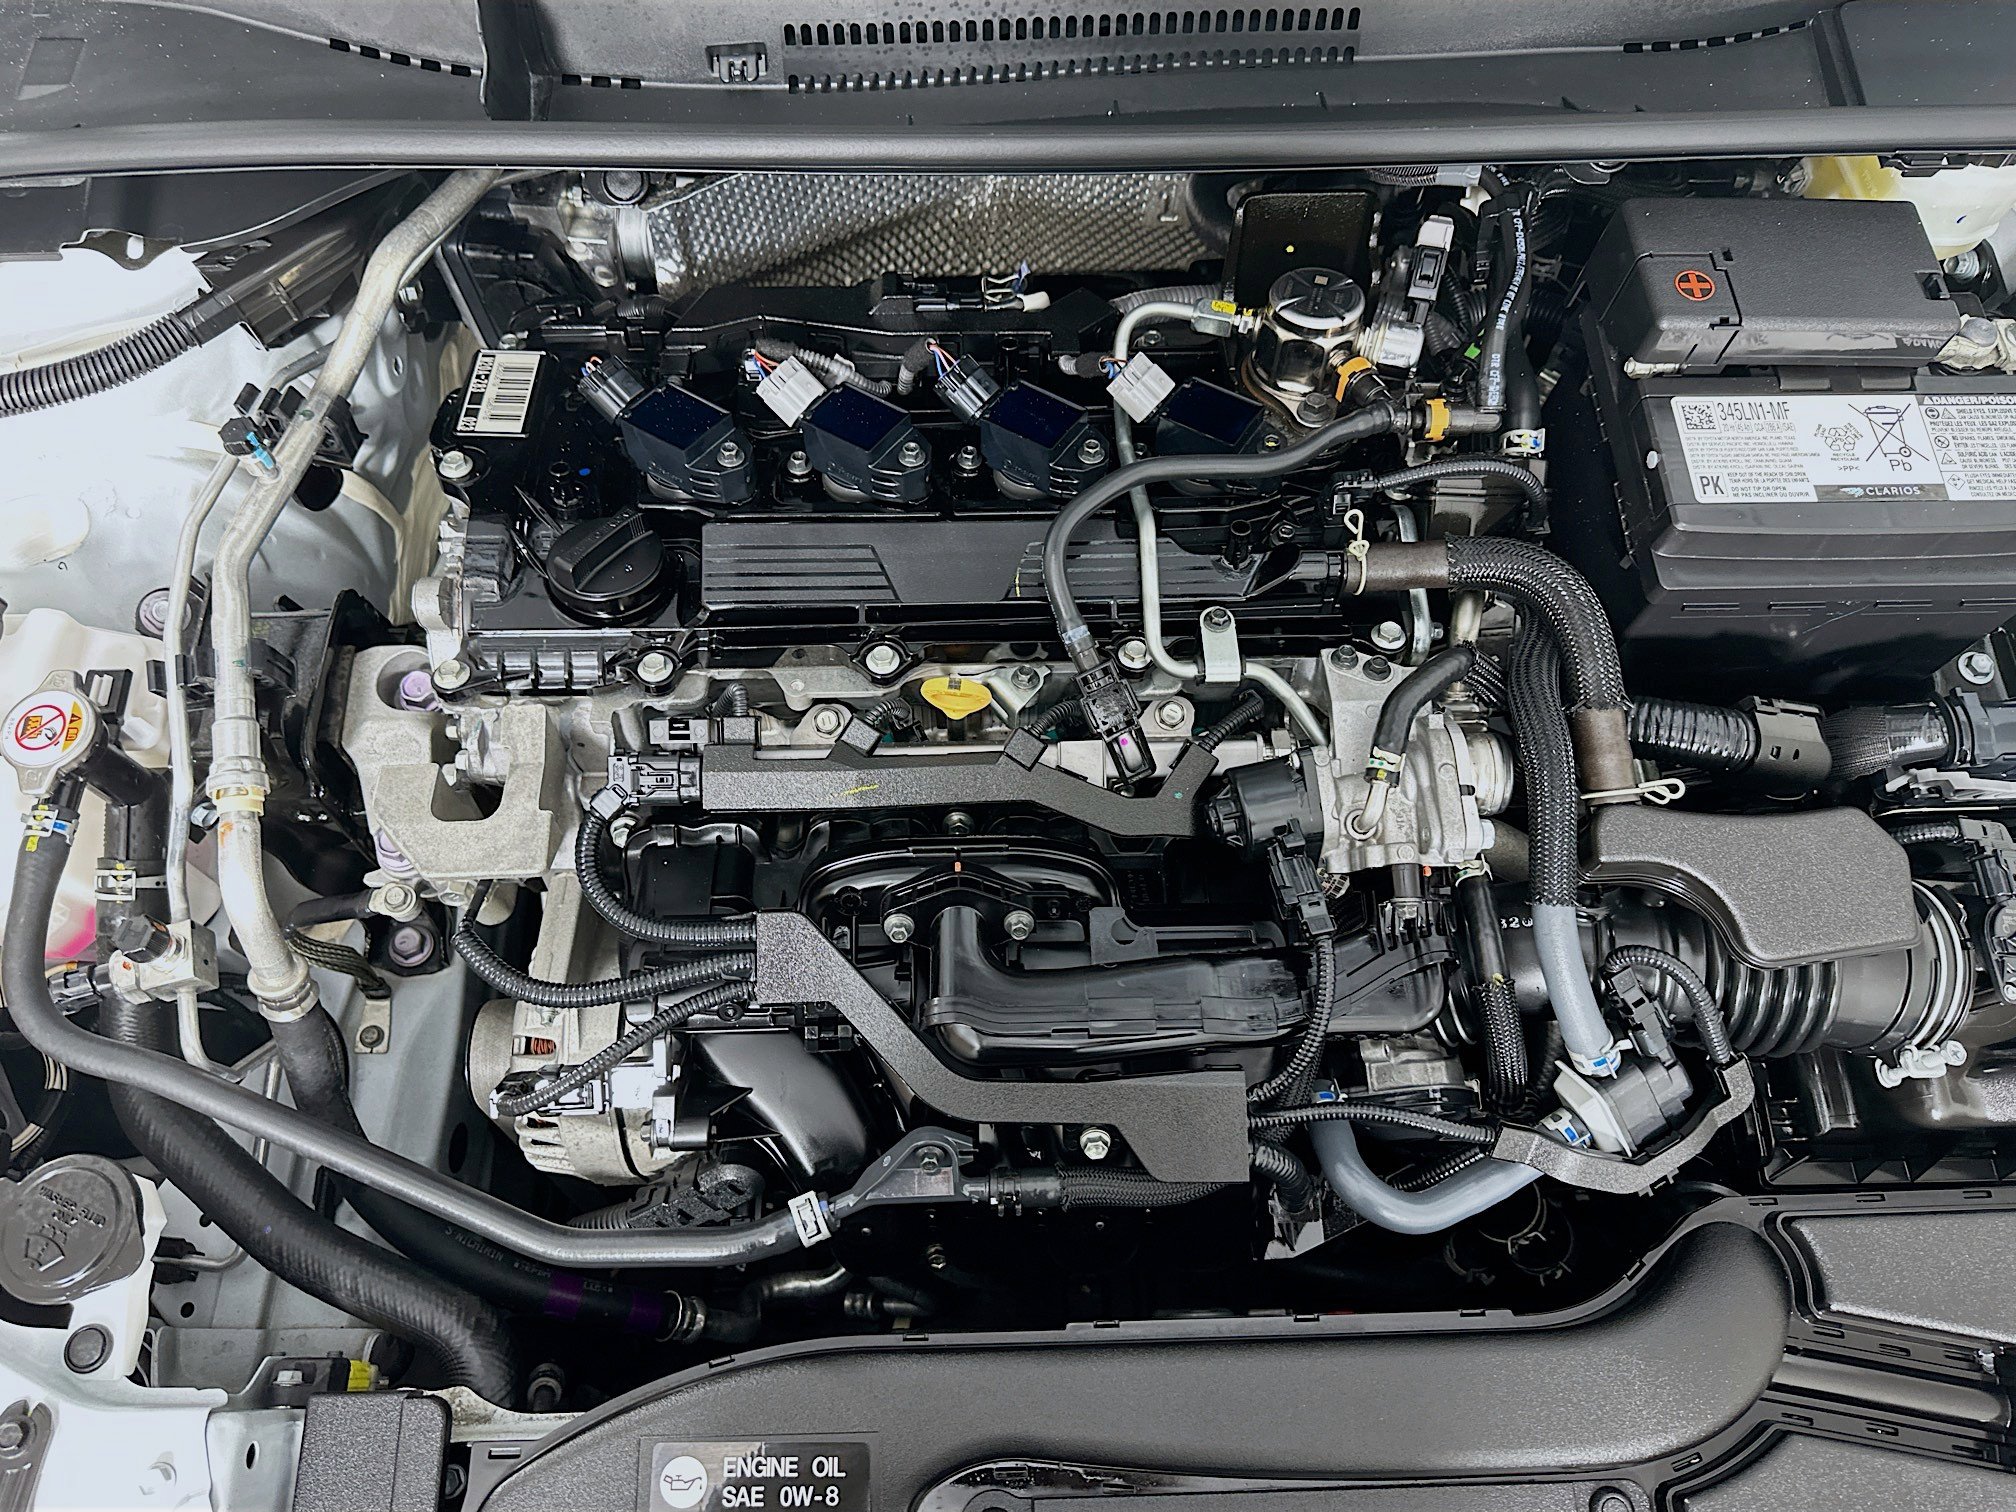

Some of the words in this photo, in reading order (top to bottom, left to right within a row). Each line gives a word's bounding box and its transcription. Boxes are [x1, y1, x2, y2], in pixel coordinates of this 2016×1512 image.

[1932, 396, 2016, 405] DANGER/POISO
[1717, 401, 1790, 420] 345LN1-MF
[1889, 460, 1912, 472] Pb
[1699, 476, 1725, 495] PK
[1866, 487, 1920, 496] CLARIOS
[723, 1456, 799, 1478] ENGINE
[812, 1456, 846, 1478] OIL
[721, 1485, 765, 1507] SAE
[779, 1485, 840, 1507] 0W-8
